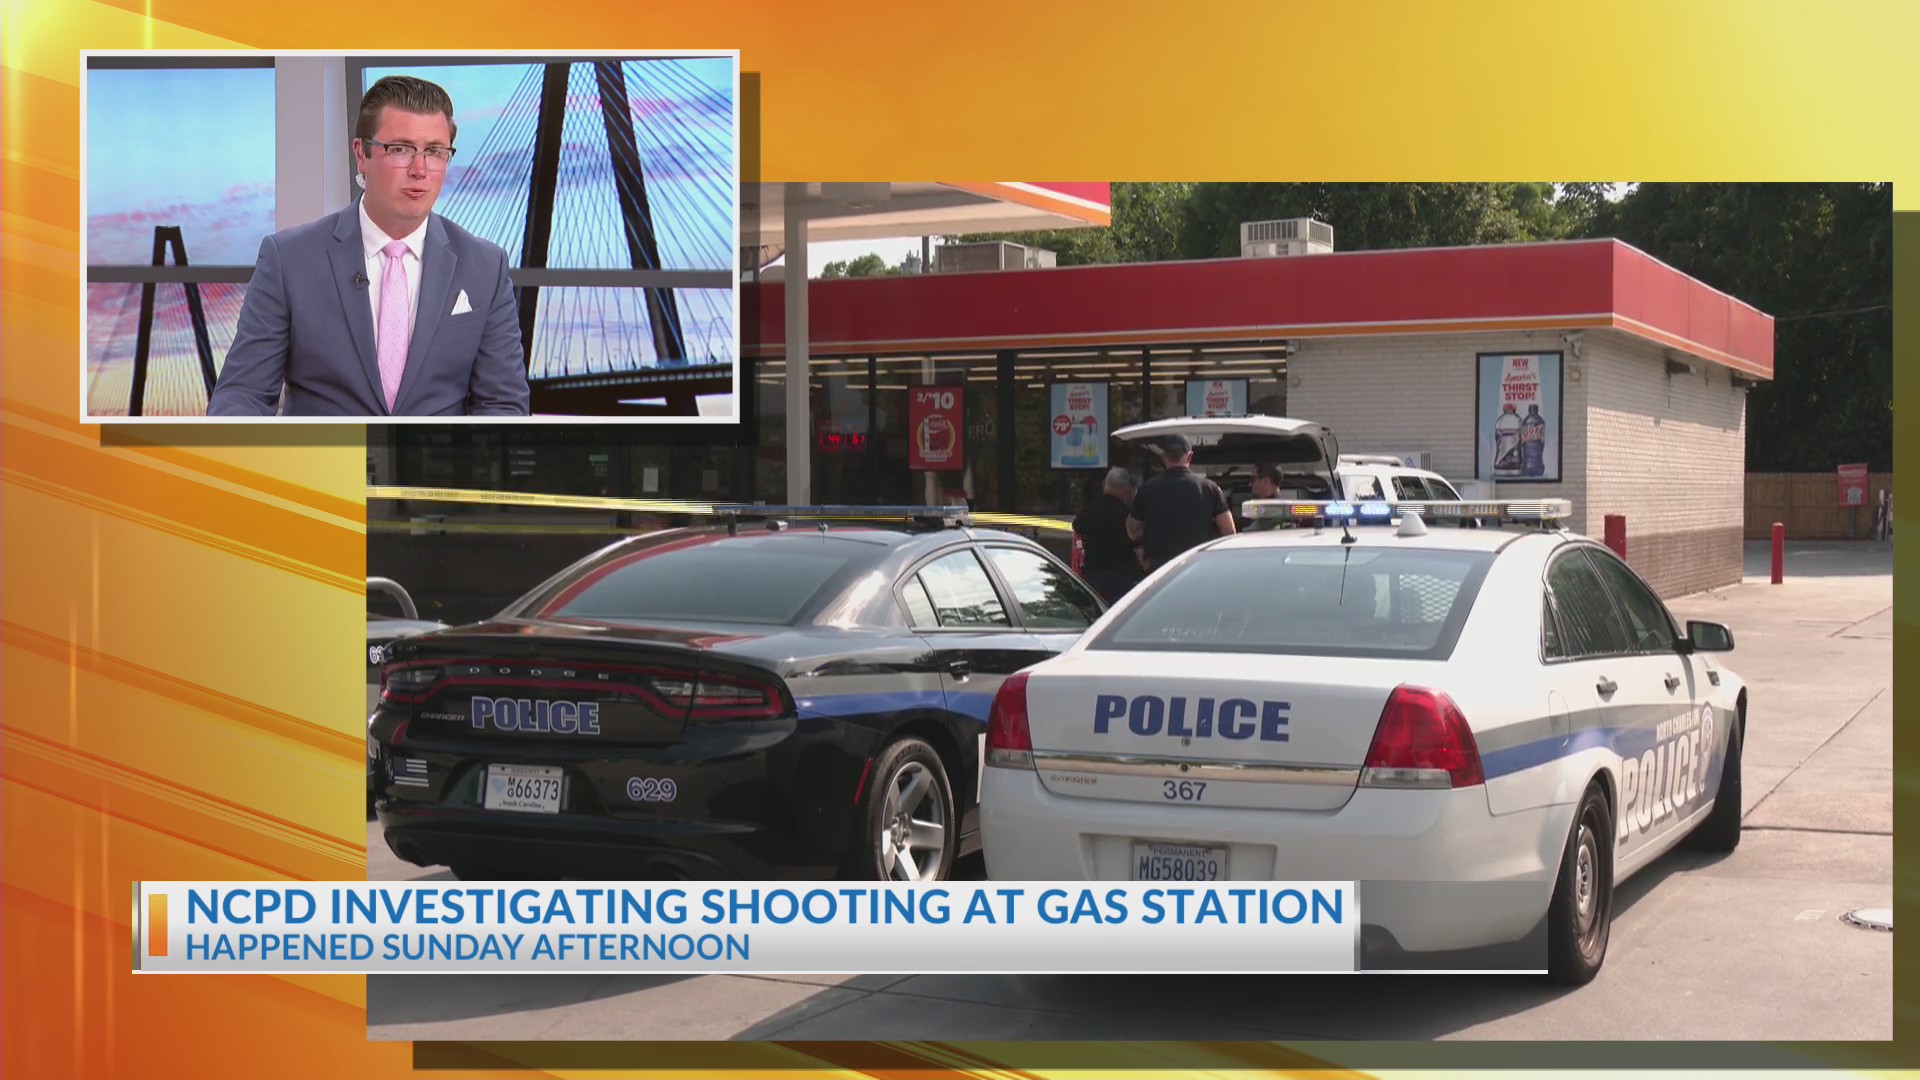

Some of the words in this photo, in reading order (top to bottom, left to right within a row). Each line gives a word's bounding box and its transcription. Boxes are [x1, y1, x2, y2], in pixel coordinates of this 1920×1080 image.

[1512, 357, 1529, 368] NEW
[1502, 382, 1539, 392] THIRST
[1504, 392, 1535, 400] STOP!
[1068, 397, 1092, 405] THIRST
[1206, 396, 1229, 404] THIRST
[471, 696, 601, 735] POLICE
[1093, 695, 1291, 742] POLICE
[515, 778, 560, 801] 66373
[626, 776, 678, 802] 629
[1162, 780, 1207, 801] 367
[1618, 728, 1700, 840] POLICE
[1152, 847, 1206, 858] PERMANENT
[1138, 856, 1218, 881] MG58039
